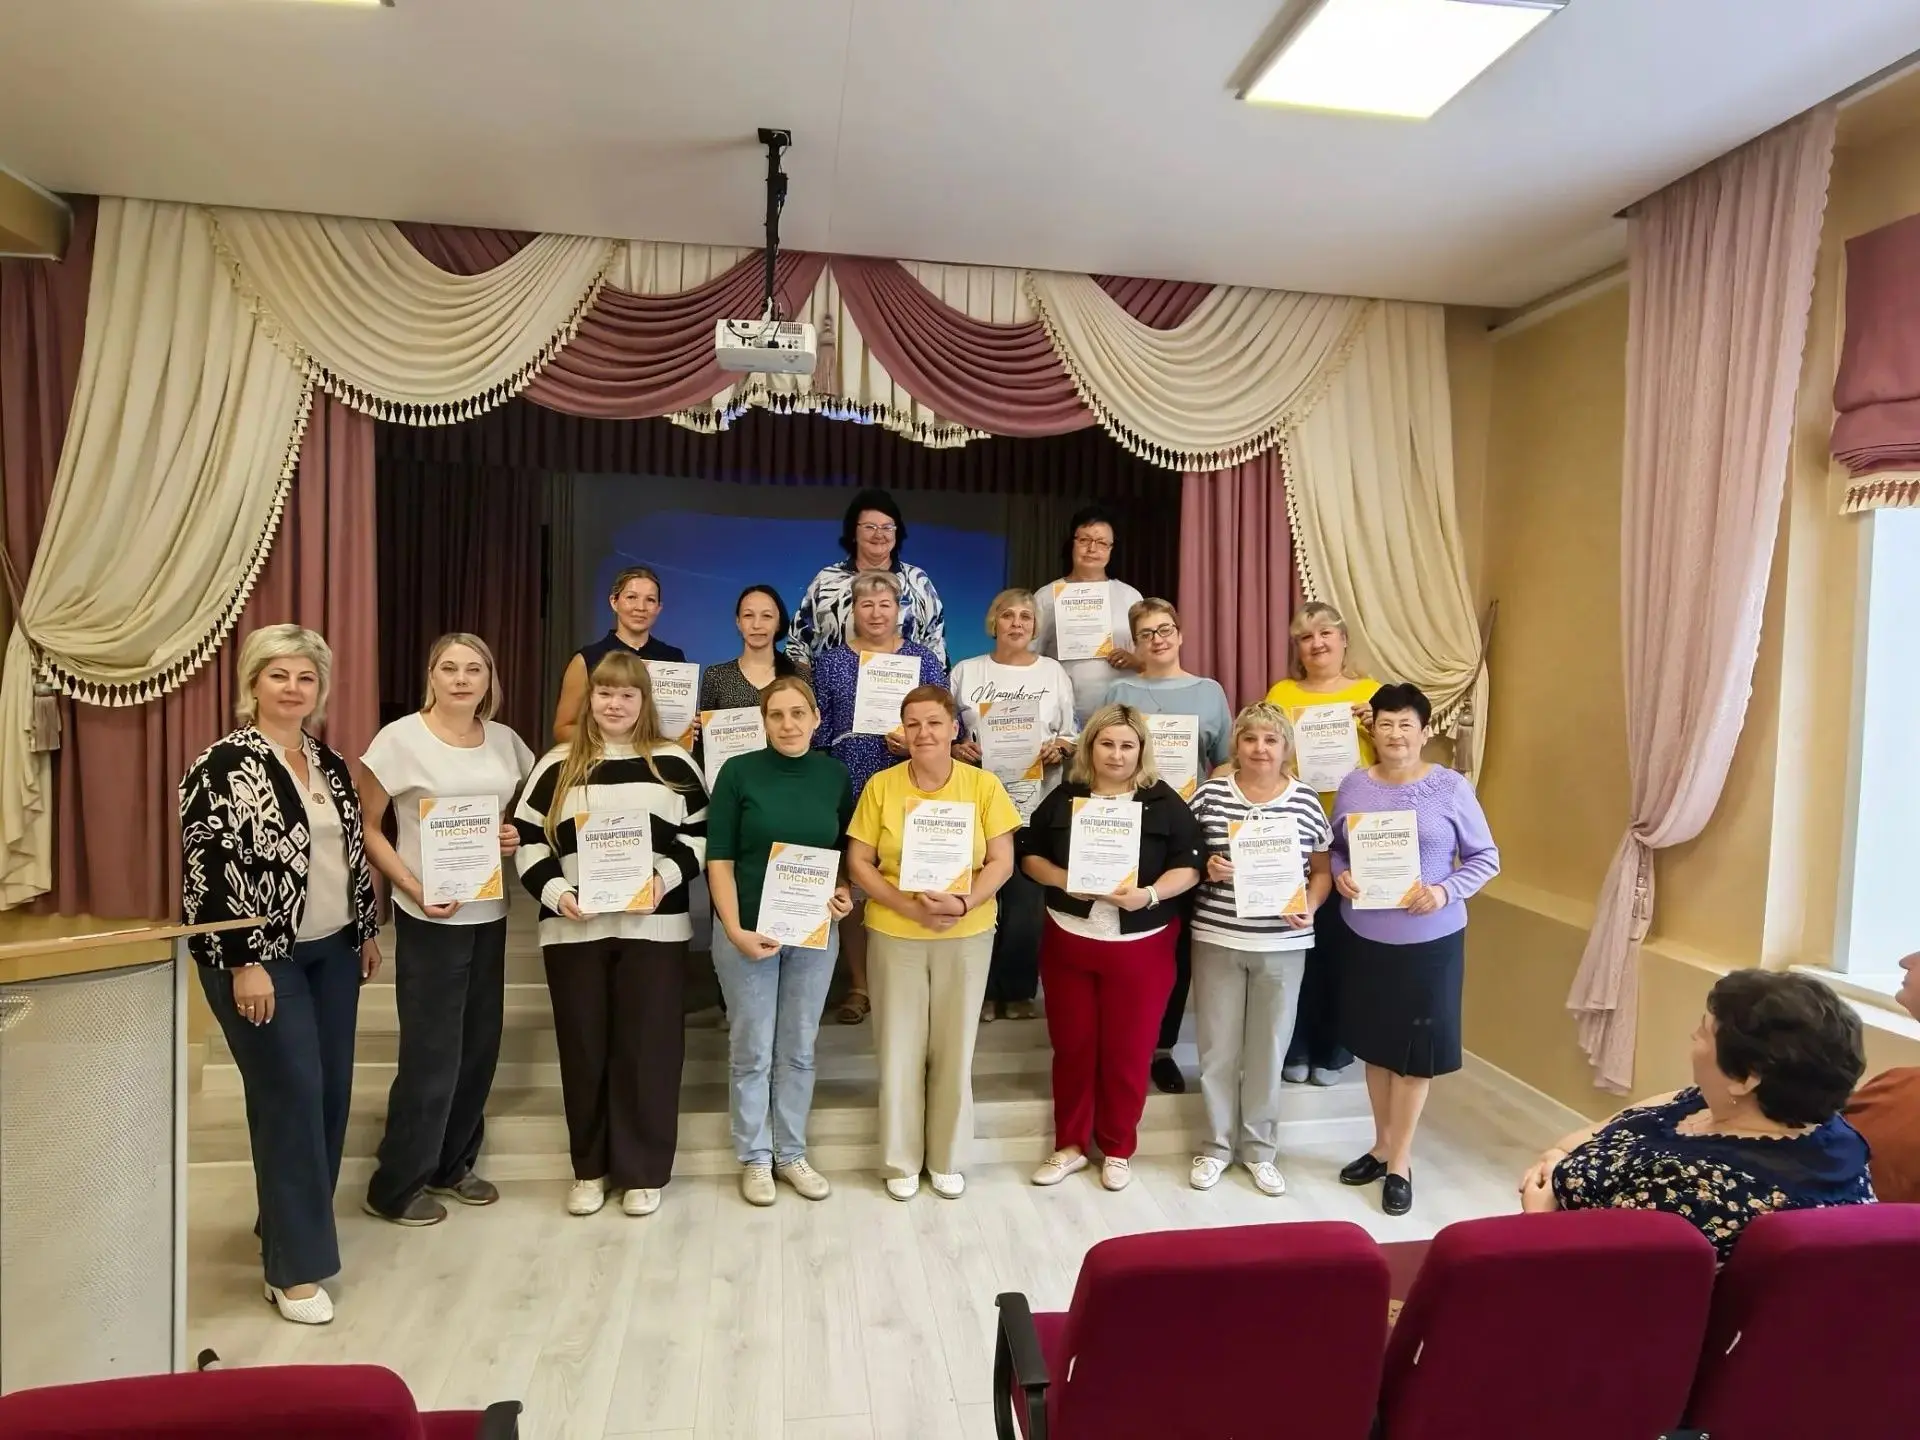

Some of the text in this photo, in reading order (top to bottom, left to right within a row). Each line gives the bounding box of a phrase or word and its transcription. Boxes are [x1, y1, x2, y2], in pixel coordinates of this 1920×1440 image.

[430, 817, 491, 829] БЛАГОДАРСТВЕННОЕ
[435, 826, 488, 837] ПИСЬМО
[585, 829, 643, 841] БЛАГОДАРСТВЕННОЕ
[1084, 826, 1130, 835] ПИСЬМО
[590, 838, 640, 849] ПИСЬМО
[1361, 839, 1408, 849] ПИСЬМО
[776, 863, 830, 879] БЛАГОДАРСТВЕННОЕ
[778, 872, 826, 885] ПИСЬМО
